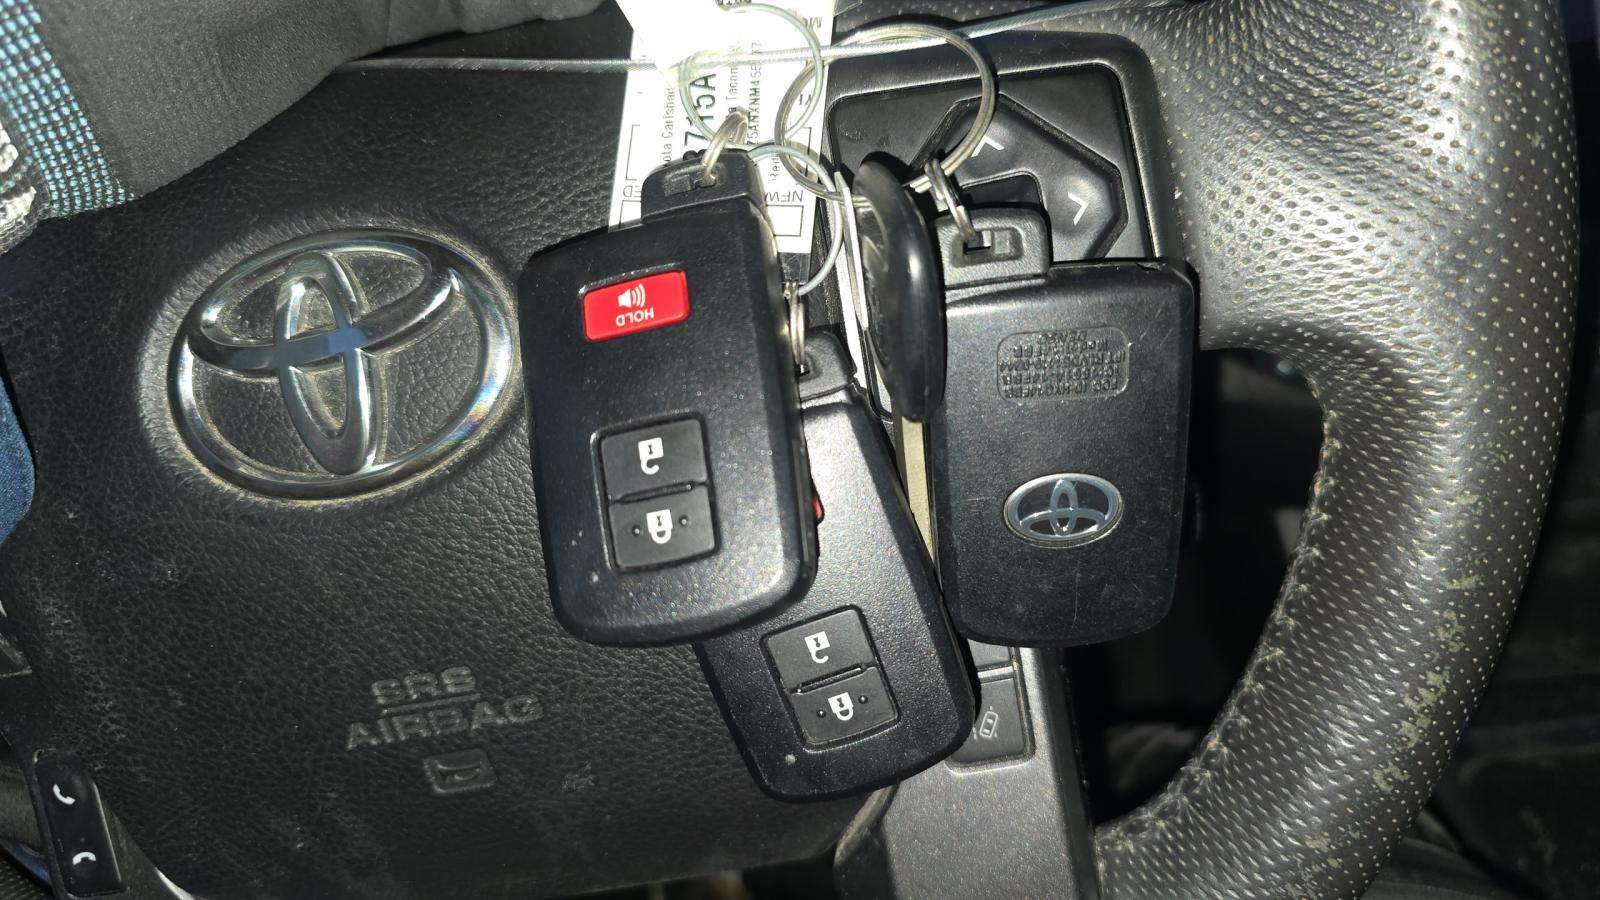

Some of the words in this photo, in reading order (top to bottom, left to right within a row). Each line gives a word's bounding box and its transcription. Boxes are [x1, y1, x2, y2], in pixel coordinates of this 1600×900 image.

[615, 307, 655, 327] HOLD
[371, 666, 476, 704] SRS
[346, 694, 544, 750] AIRBAG
